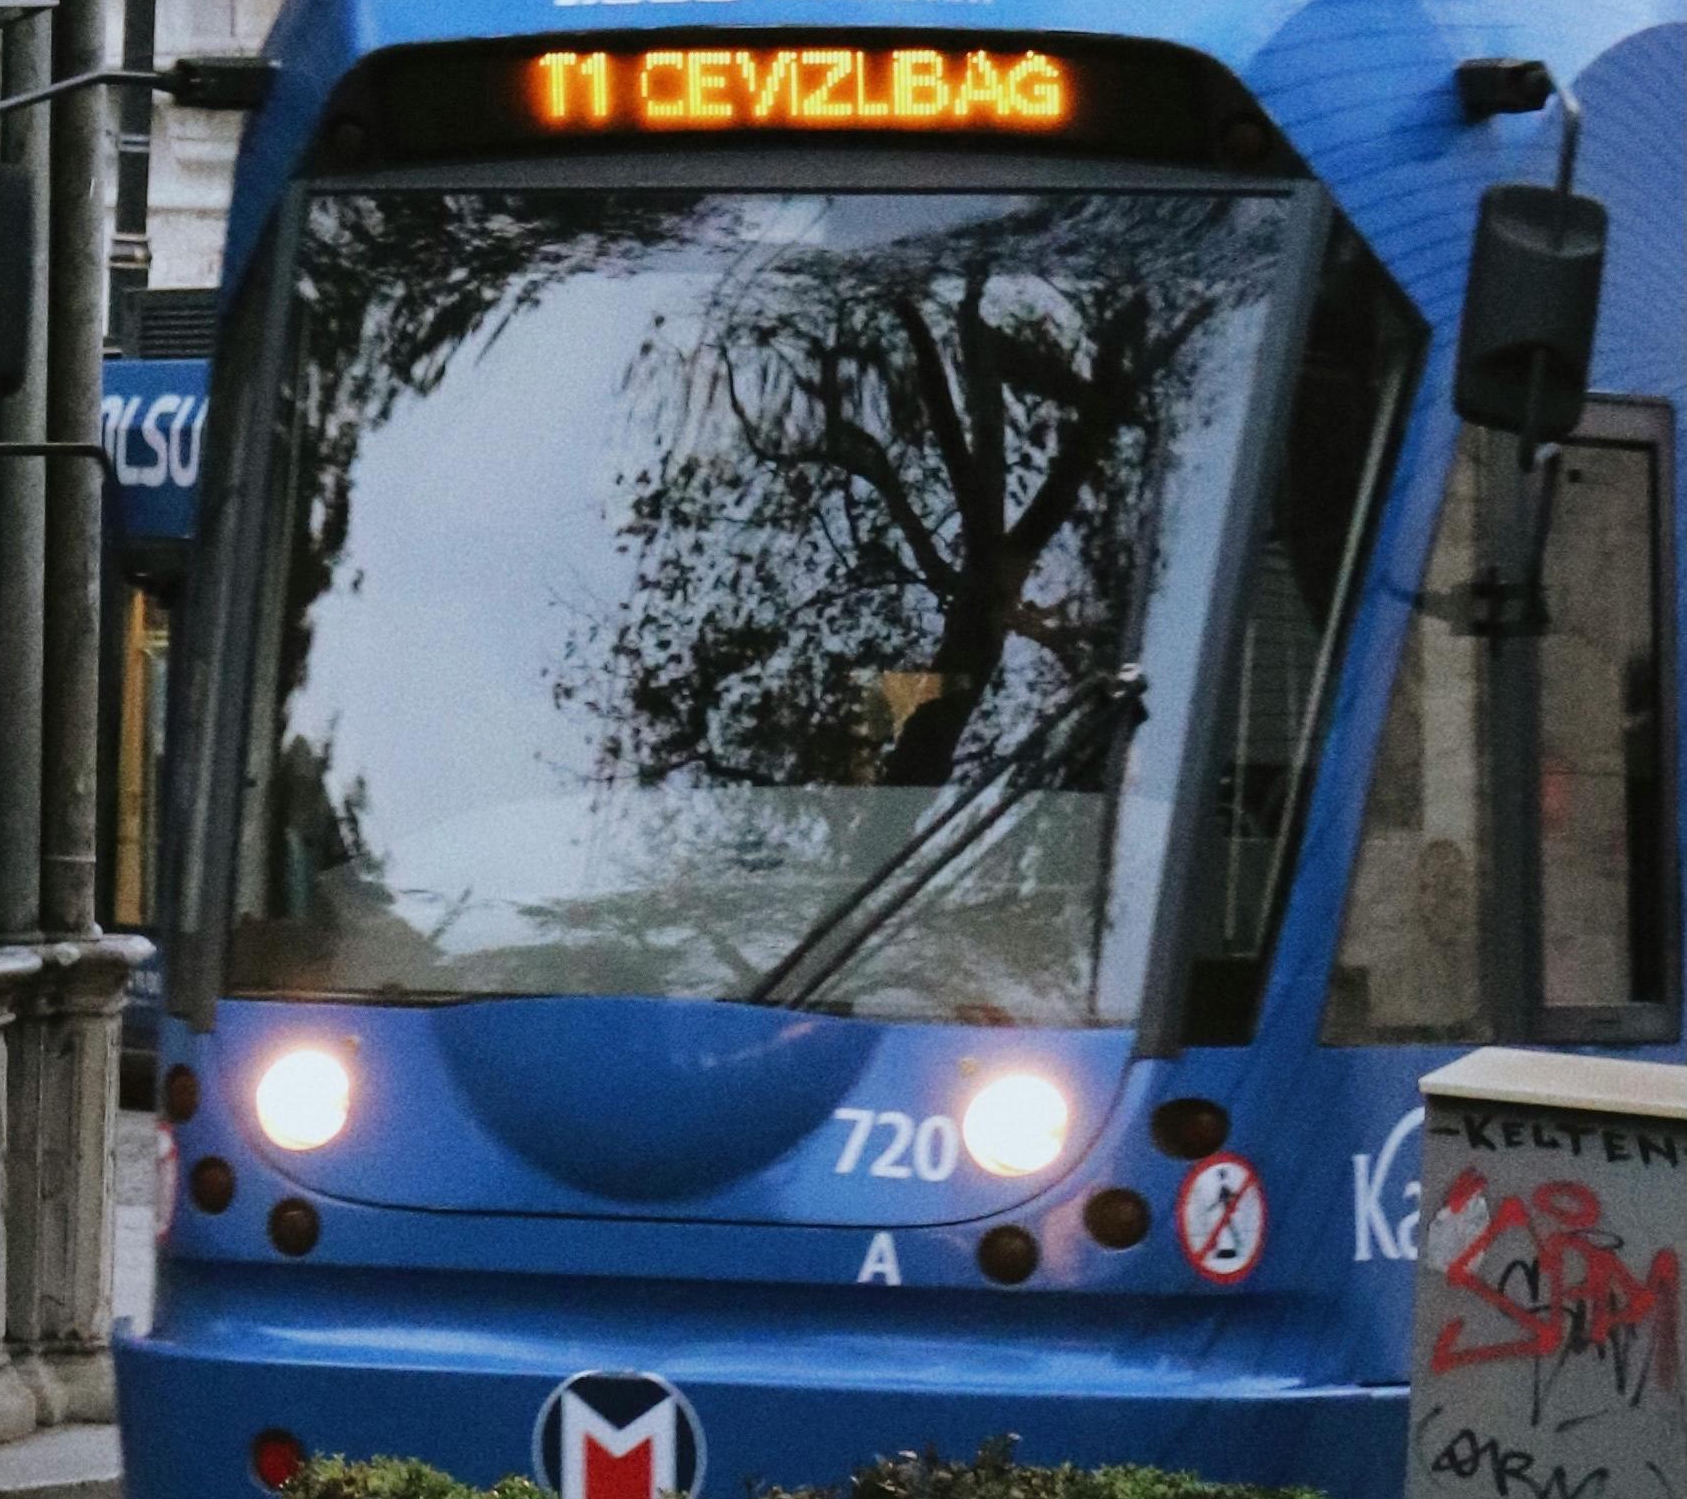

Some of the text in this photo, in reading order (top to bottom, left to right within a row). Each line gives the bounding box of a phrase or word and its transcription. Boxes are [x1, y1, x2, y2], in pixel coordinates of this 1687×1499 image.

[539, 51, 607, 117] T1
[833, 1108, 960, 1182] 720
[856, 1230, 903, 1287] A
